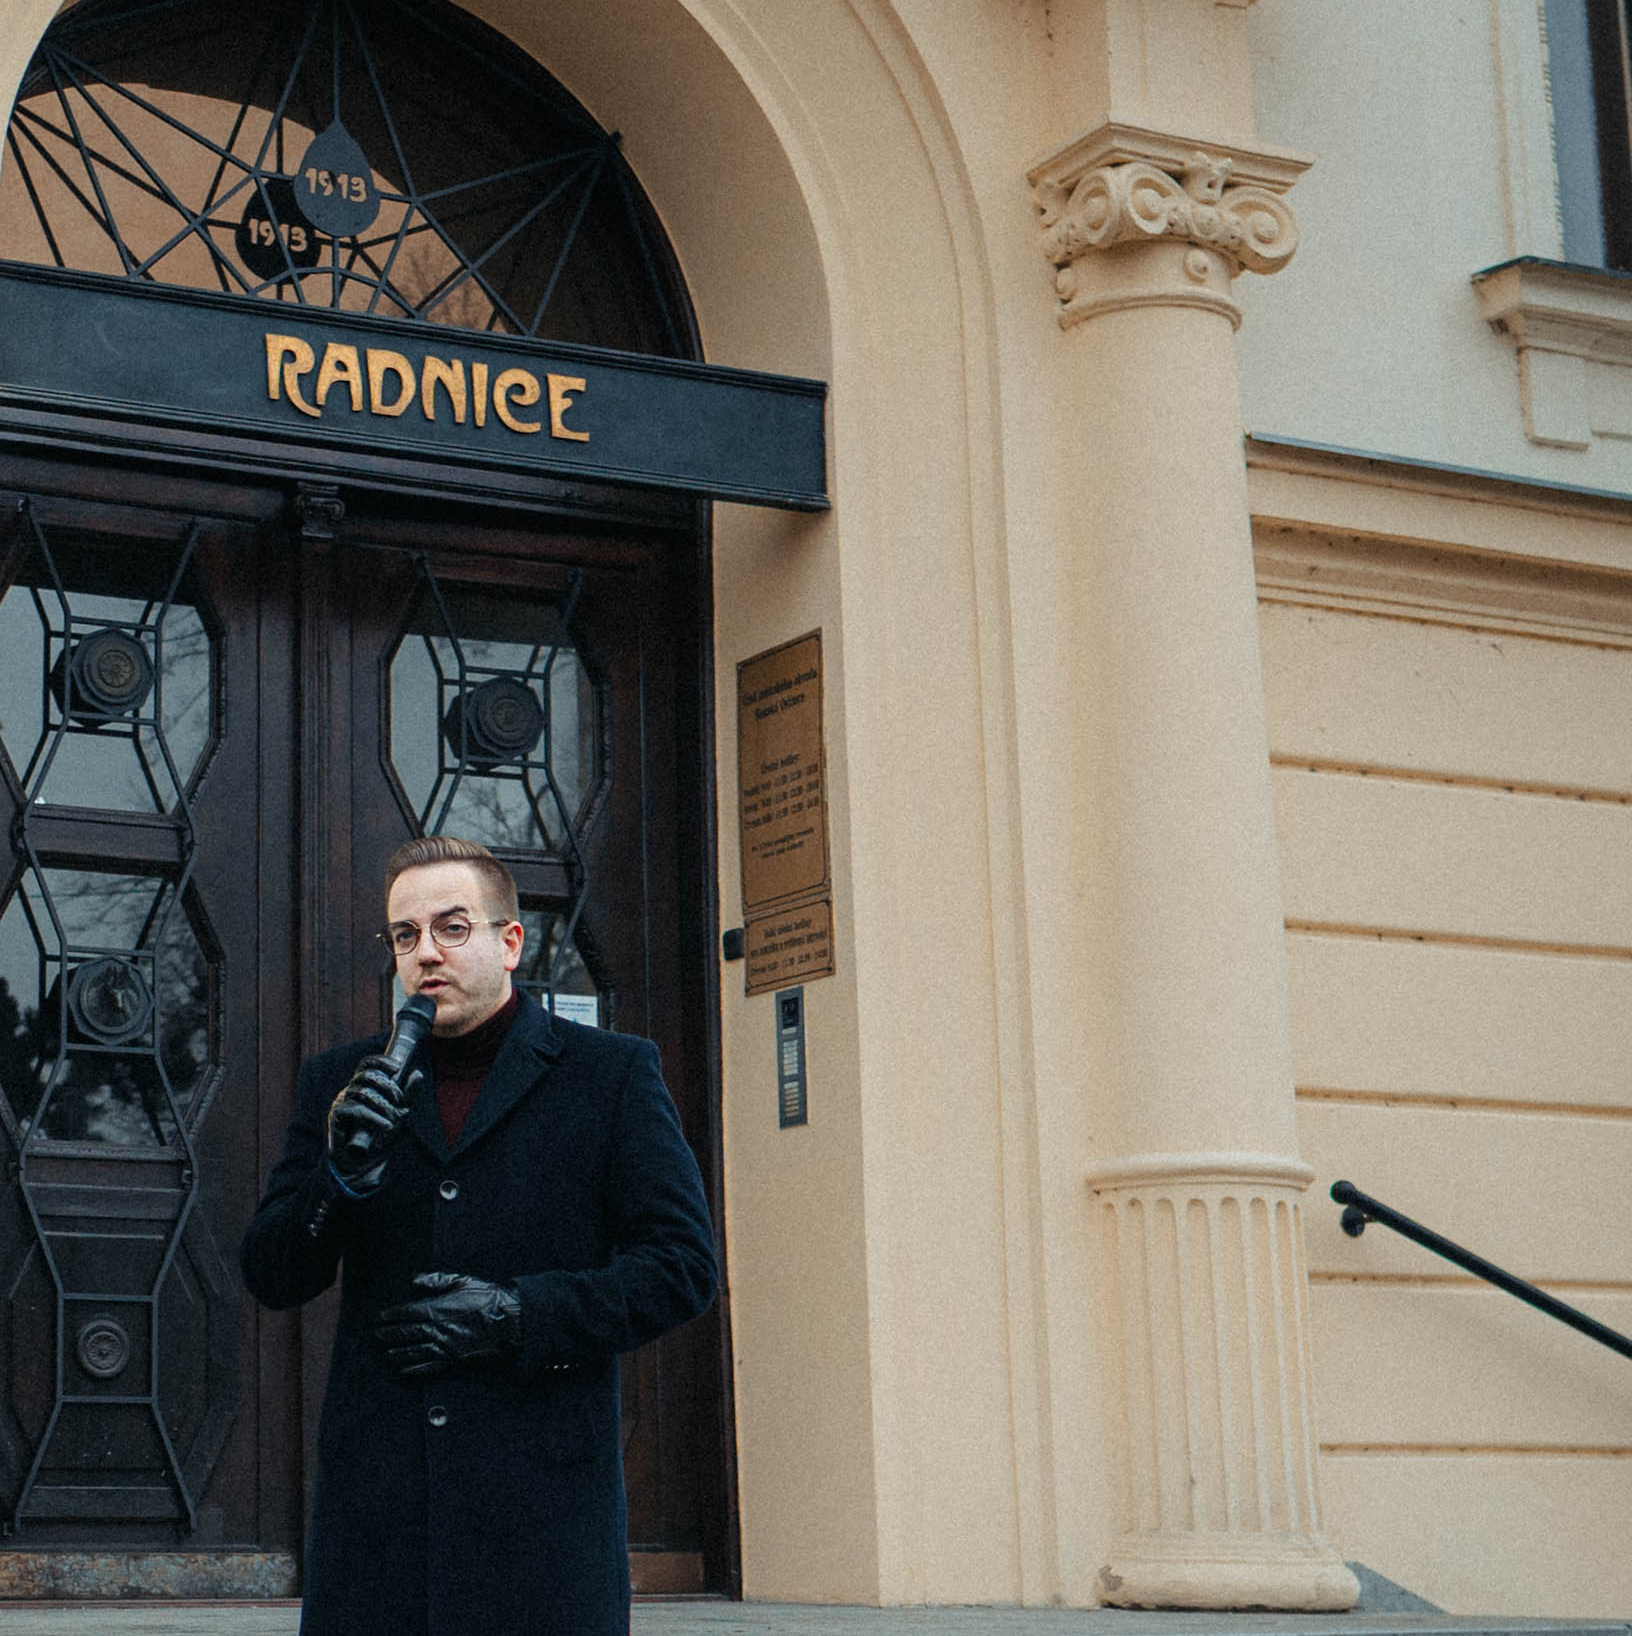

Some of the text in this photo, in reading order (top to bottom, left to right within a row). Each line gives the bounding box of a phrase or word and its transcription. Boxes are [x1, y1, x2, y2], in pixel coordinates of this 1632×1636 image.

[305, 167, 367, 203] 1913
[248, 217, 308, 252] 1913
[265, 333, 590, 442] RADNICE
